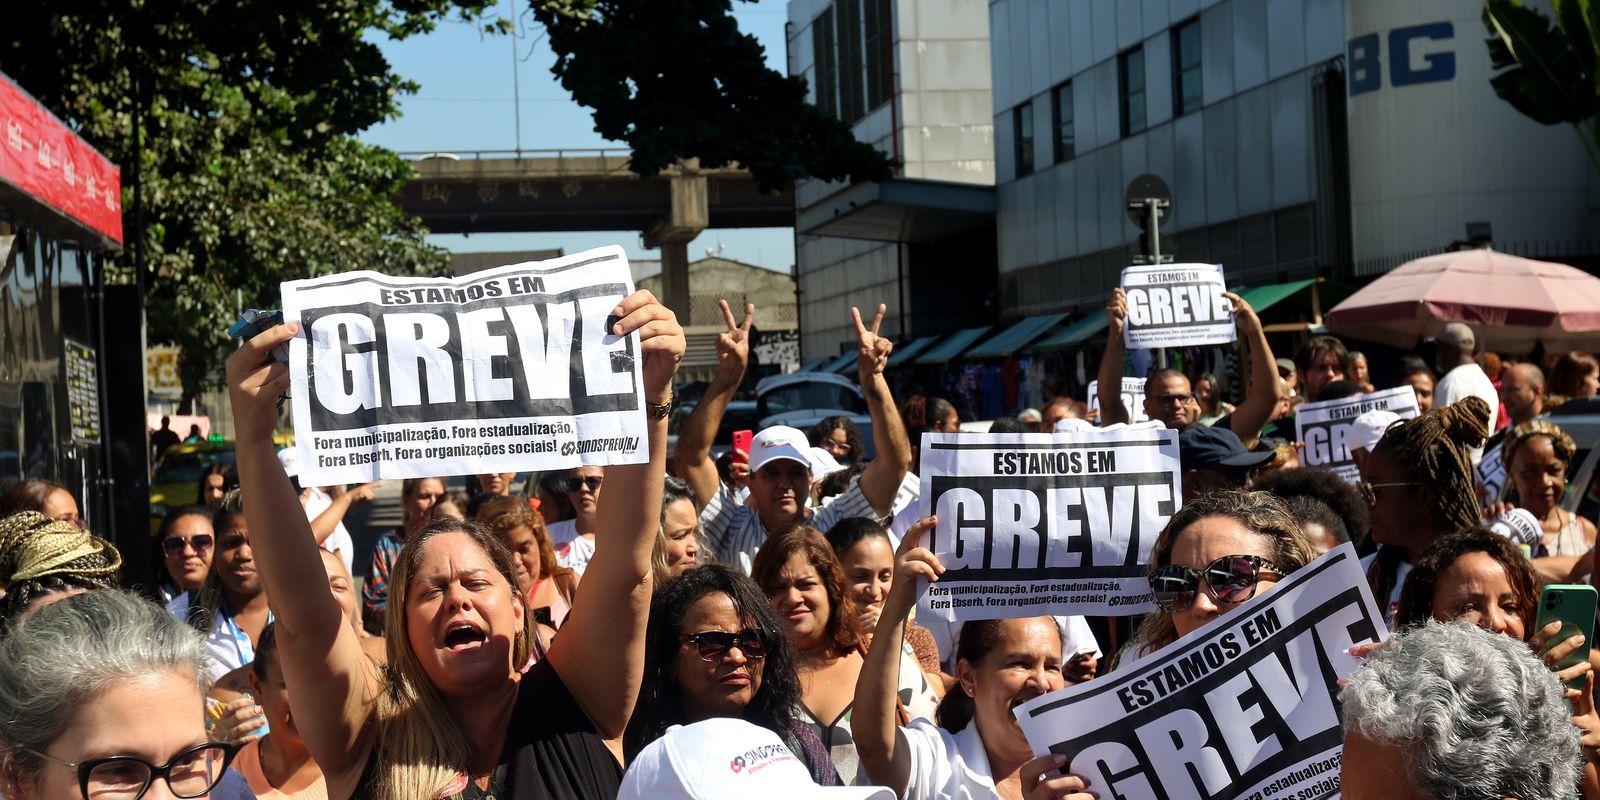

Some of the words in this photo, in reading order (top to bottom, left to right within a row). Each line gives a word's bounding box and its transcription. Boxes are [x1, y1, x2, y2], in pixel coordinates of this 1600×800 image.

[1348, 21, 1456, 98] BG
[380, 280, 503, 305] ESTAMOS
[507, 276, 546, 295] EM
[1147, 271, 1187, 284] ESTAMOS
[1127, 284, 1231, 326] GREVE
[310, 295, 634, 415] GREVE
[1329, 402, 1373, 420] ESTAMOS
[314, 436, 342, 450] Fora
[344, 426, 450, 448] municipalização,
[451, 425, 477, 439] Fora
[479, 421, 574, 438] estadualização,
[318, 454, 347, 468] Fora
[349, 448, 393, 466] Ebserh,
[395, 447, 422, 460] Fora
[424, 441, 506, 459] organizações
[508, 439, 557, 455] sociais!
[993, 451, 1083, 475] ESTAMOS
[1087, 450, 1116, 473] EM
[928, 586, 949, 597] Fora
[950, 584, 1028, 596] municipalização,
[1029, 583, 1049, 594] Fora
[1050, 581, 1122, 592] estadualização,
[930, 599, 951, 610] Fora
[952, 598, 985, 607] Ebserh,
[986, 597, 1006, 607] Fora
[1007, 594, 1068, 607] organizações
[1069, 593, 1107, 603] sociais!
[1116, 632, 1243, 713] ESTAMOS
[1242, 607, 1282, 648] EM
